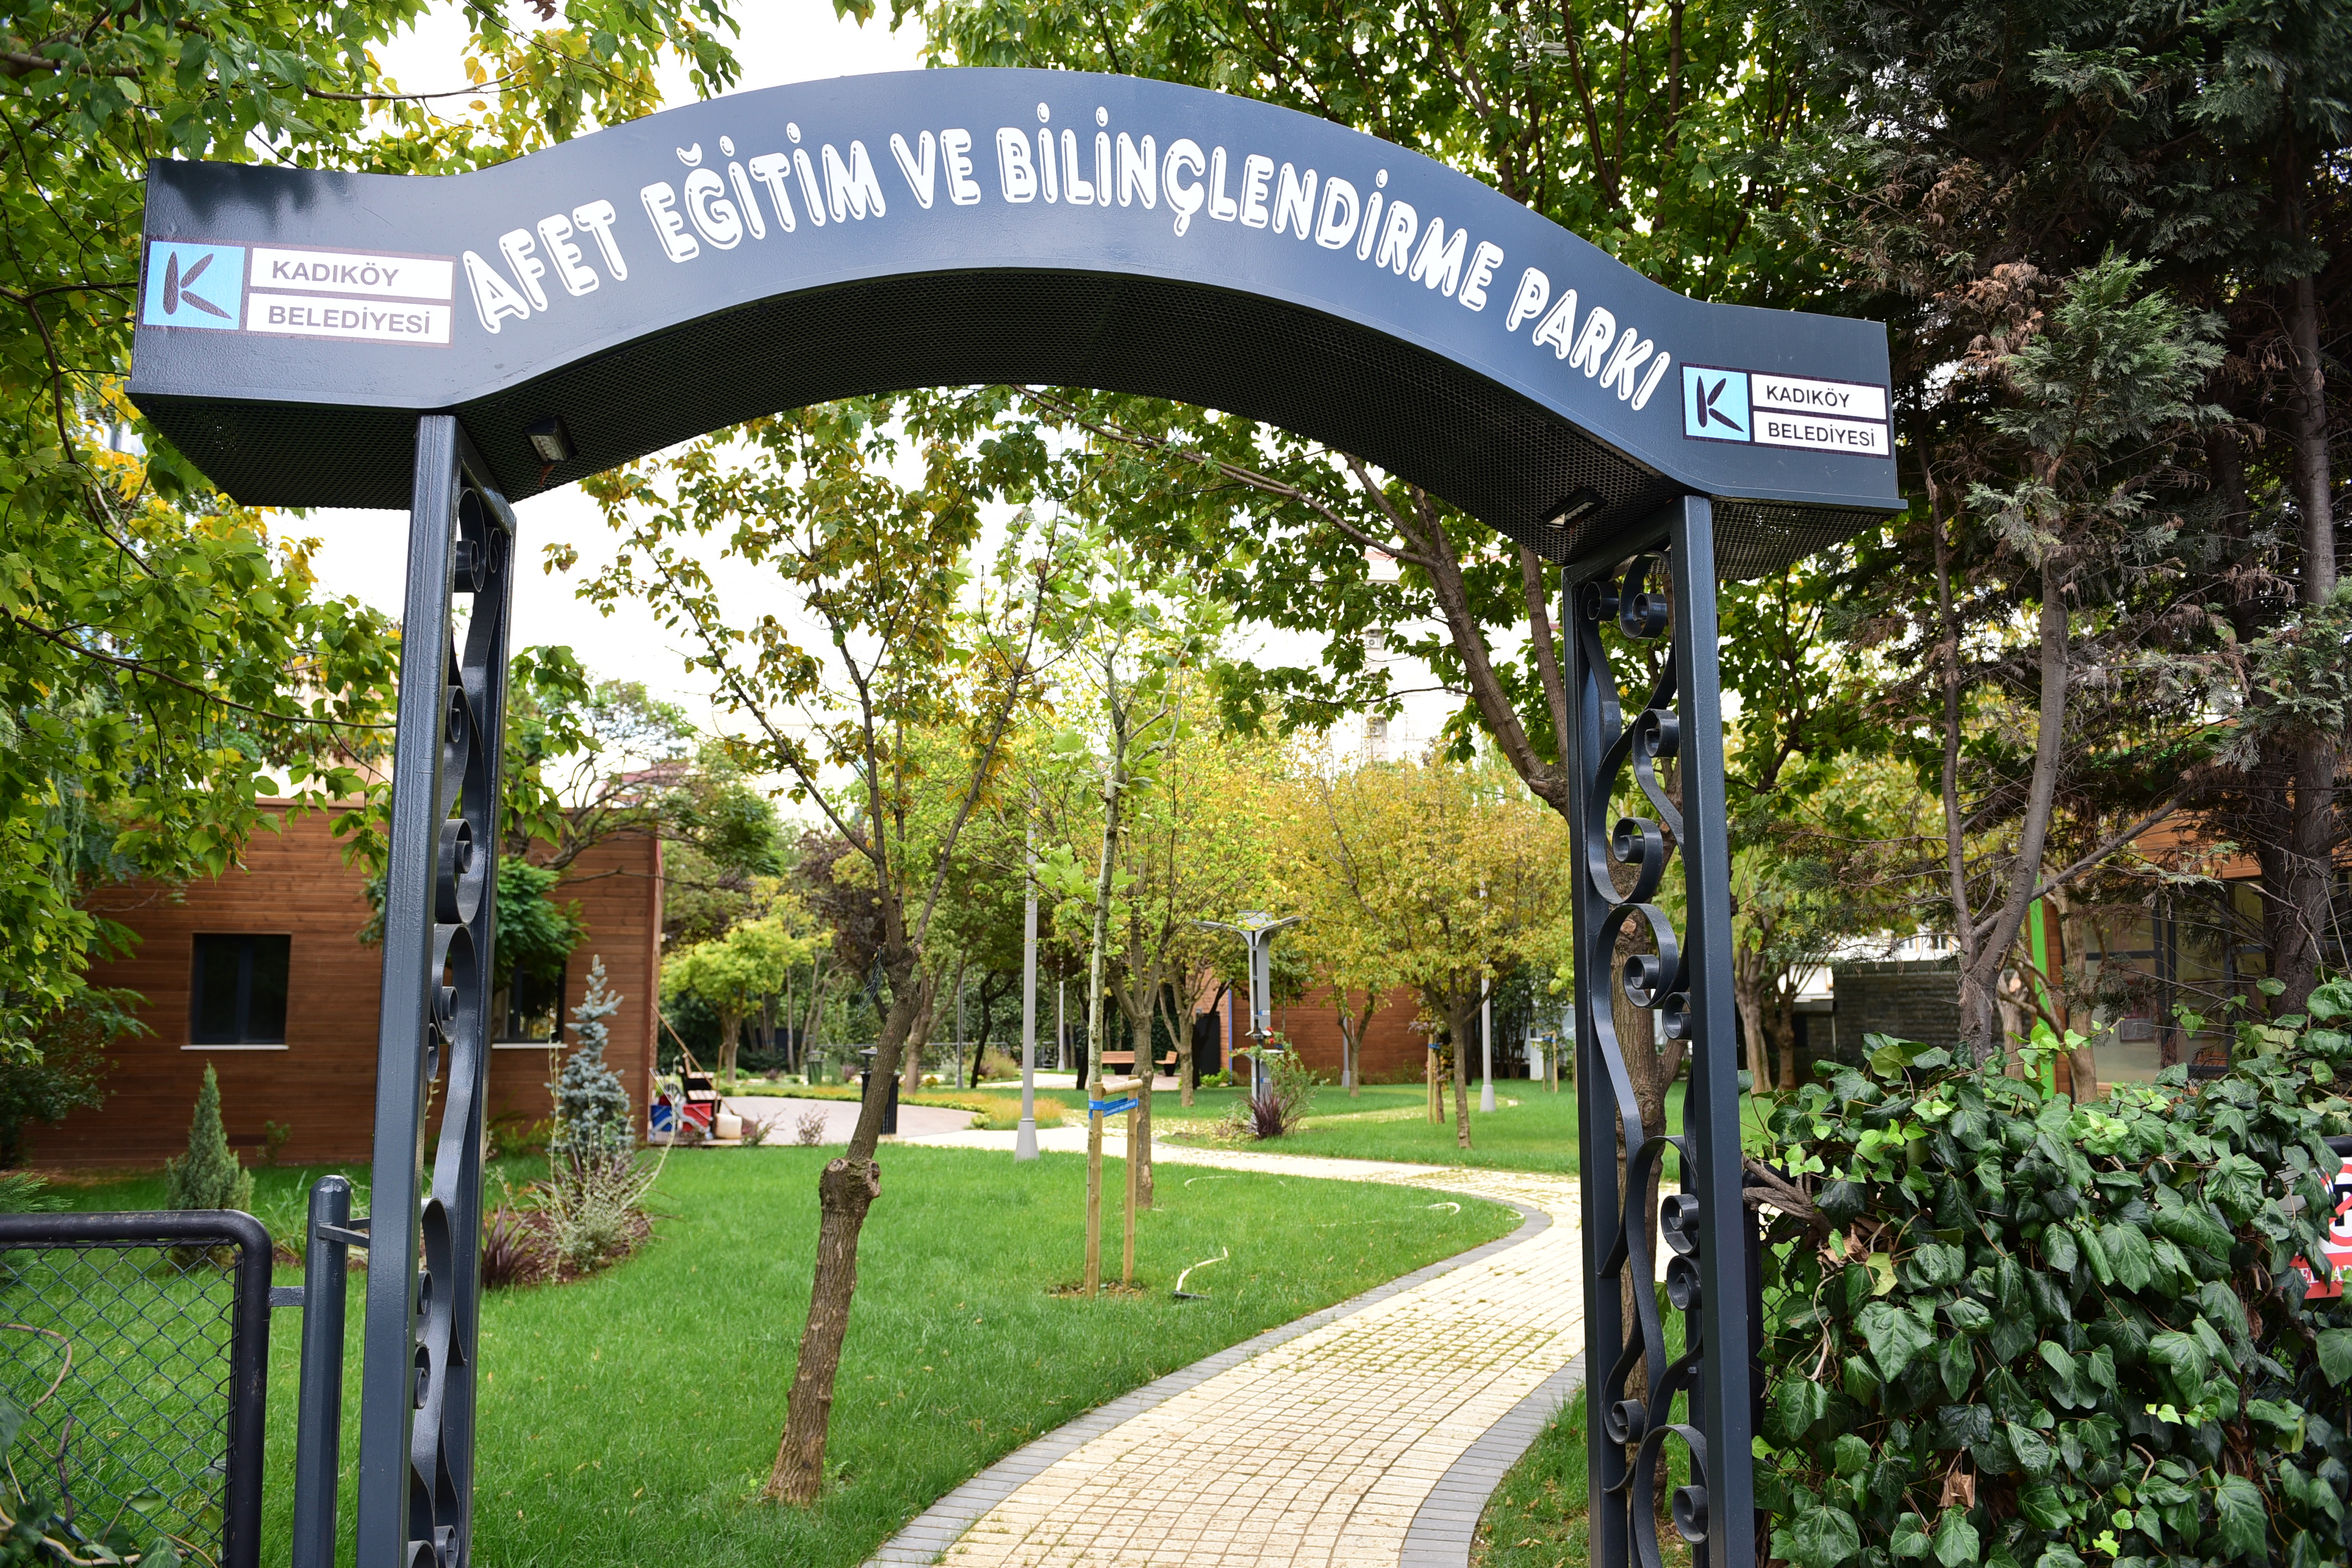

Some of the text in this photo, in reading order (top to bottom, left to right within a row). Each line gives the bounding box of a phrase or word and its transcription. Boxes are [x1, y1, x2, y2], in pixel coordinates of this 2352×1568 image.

[462, 102, 1670, 410] AFET EĞİTİM VE BİLİNÇLENDİRME PARKI
[272, 261, 399, 287] KADIKÖY
[268, 305, 430, 334] BELEDİYESİ
[1767, 385, 1849, 408] KADIKÖY
[1768, 421, 1875, 447] BELEDİYESİ
